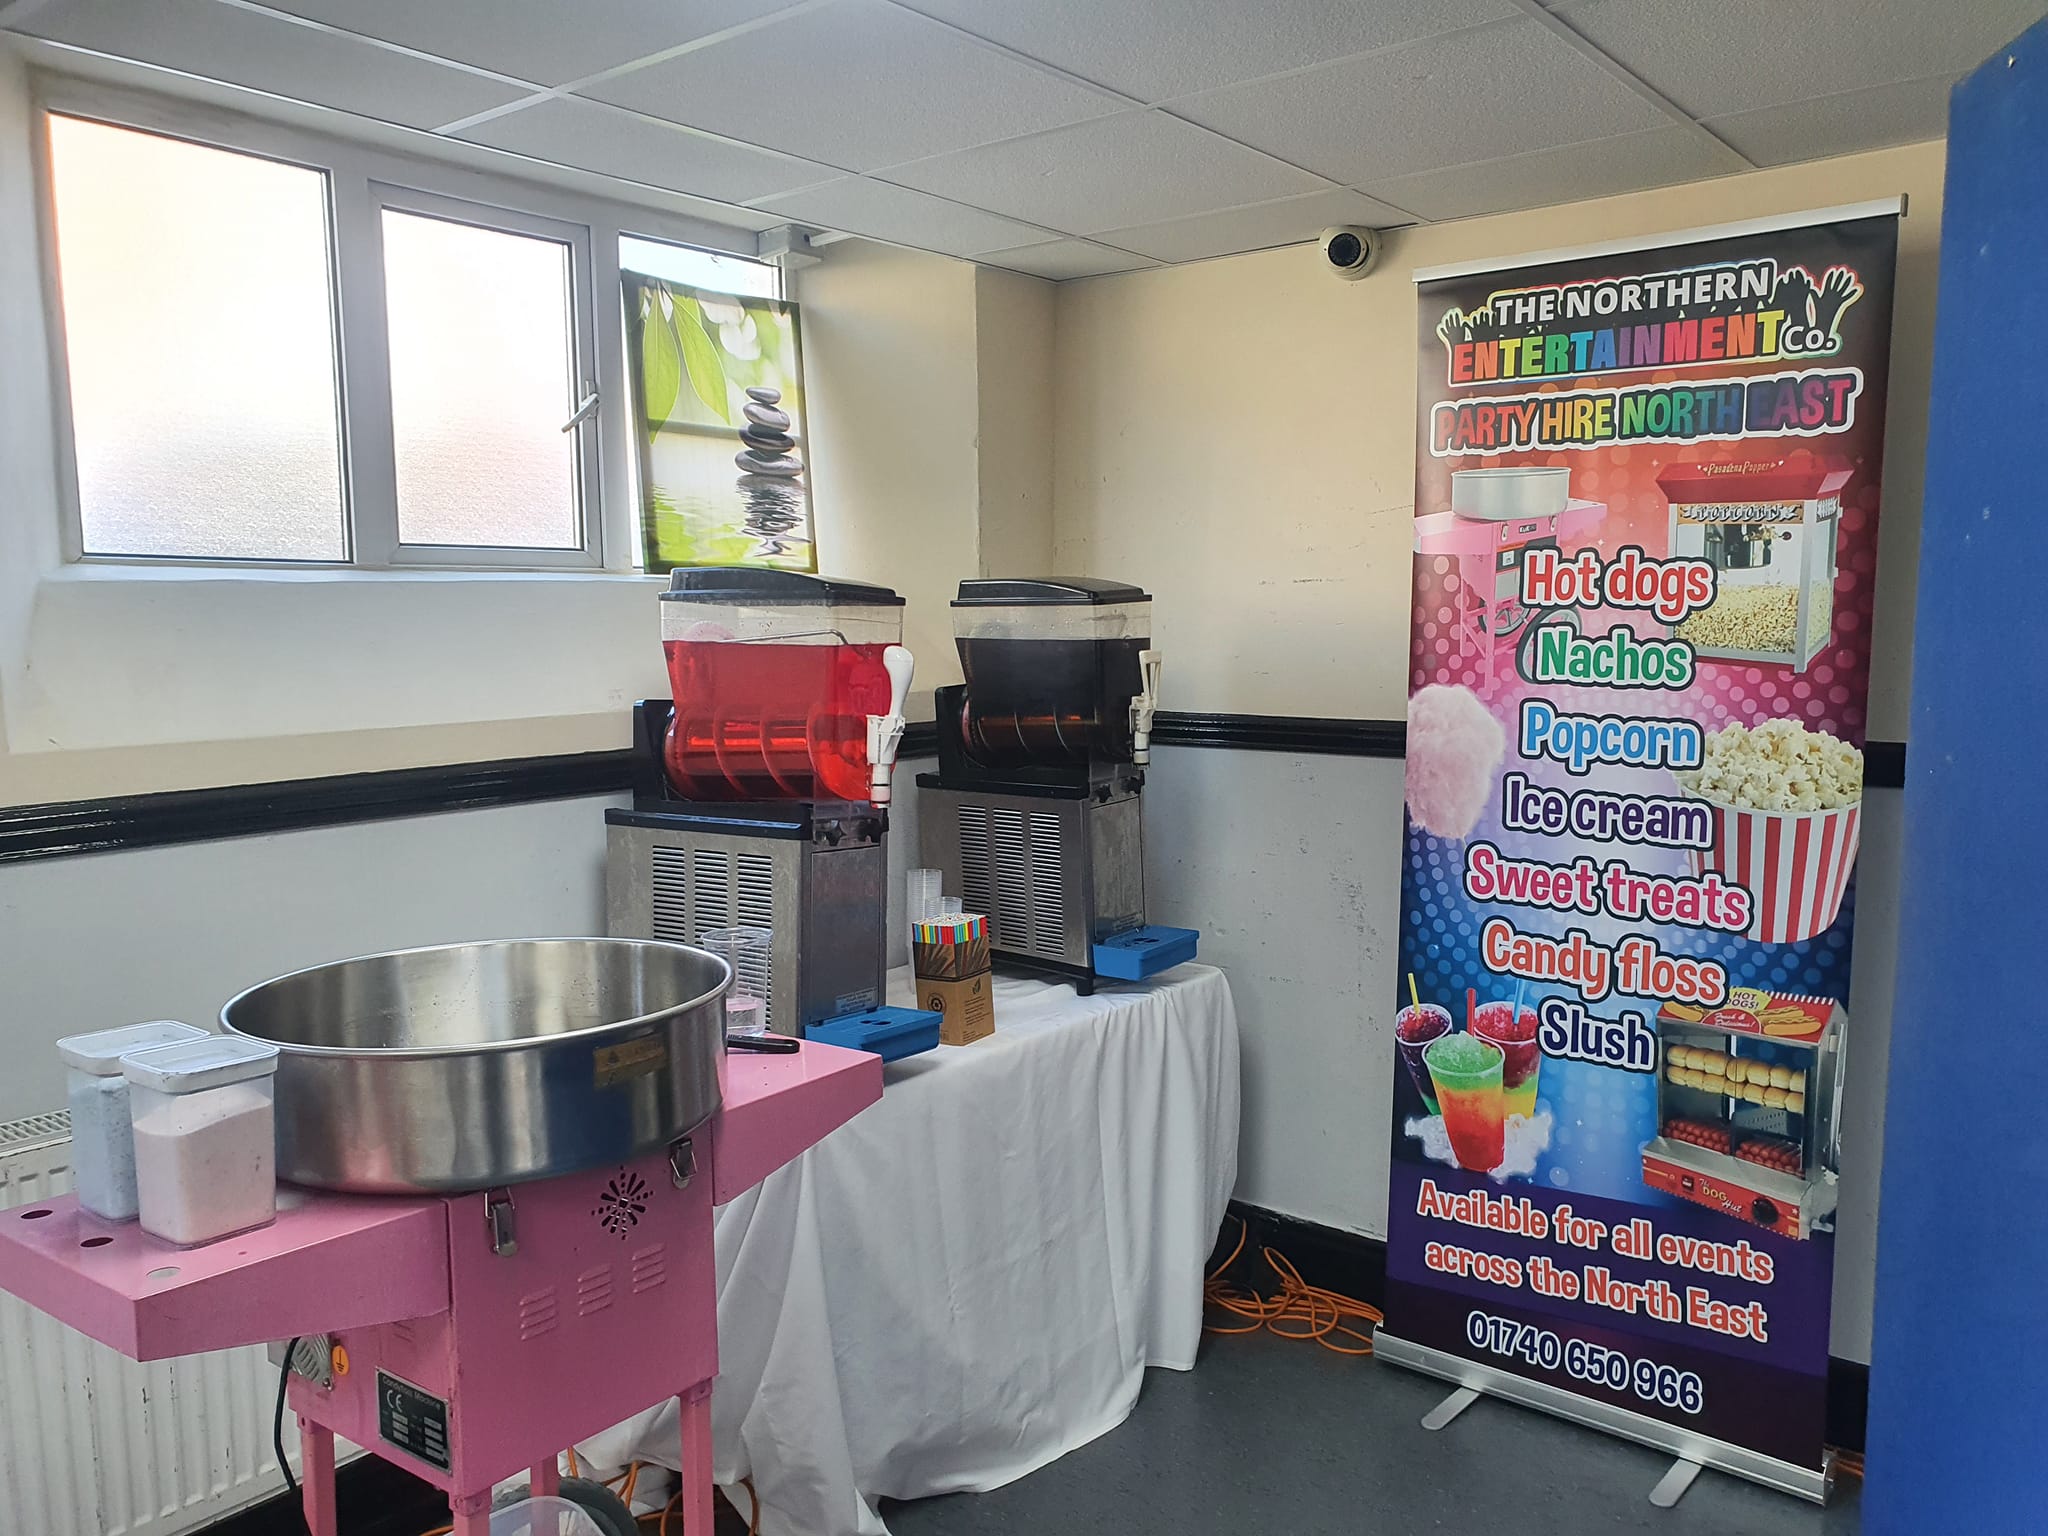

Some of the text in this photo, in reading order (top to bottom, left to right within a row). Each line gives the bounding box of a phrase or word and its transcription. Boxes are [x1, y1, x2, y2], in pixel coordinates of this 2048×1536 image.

[1495, 264, 1770, 326] THE NORTHERN
[1452, 310, 1785, 383] ENTERTAINMENT
[1435, 378, 1852, 451] PARTY HIRE NORTH EAST
[1526, 553, 1709, 618] Hot dogs
[1540, 630, 1688, 682] Nachos
[1525, 705, 1697, 768] Popcorn
[1508, 780, 1709, 843] Ice cream
[1470, 848, 1748, 928] Sweet treats
[1485, 923, 1721, 1001] Candy floss
[1732, 991, 1757, 1001] HOT
[1543, 1005, 1650, 1066] Slush
[1702, 1186, 1727, 1201] DOG
[1722, 1199, 1743, 1213] Hut
[1417, 1179, 1774, 1283] Available for all events
[1425, 1242, 1769, 1343] across the North East
[1467, 1311, 1704, 1414] 01740 650 966
